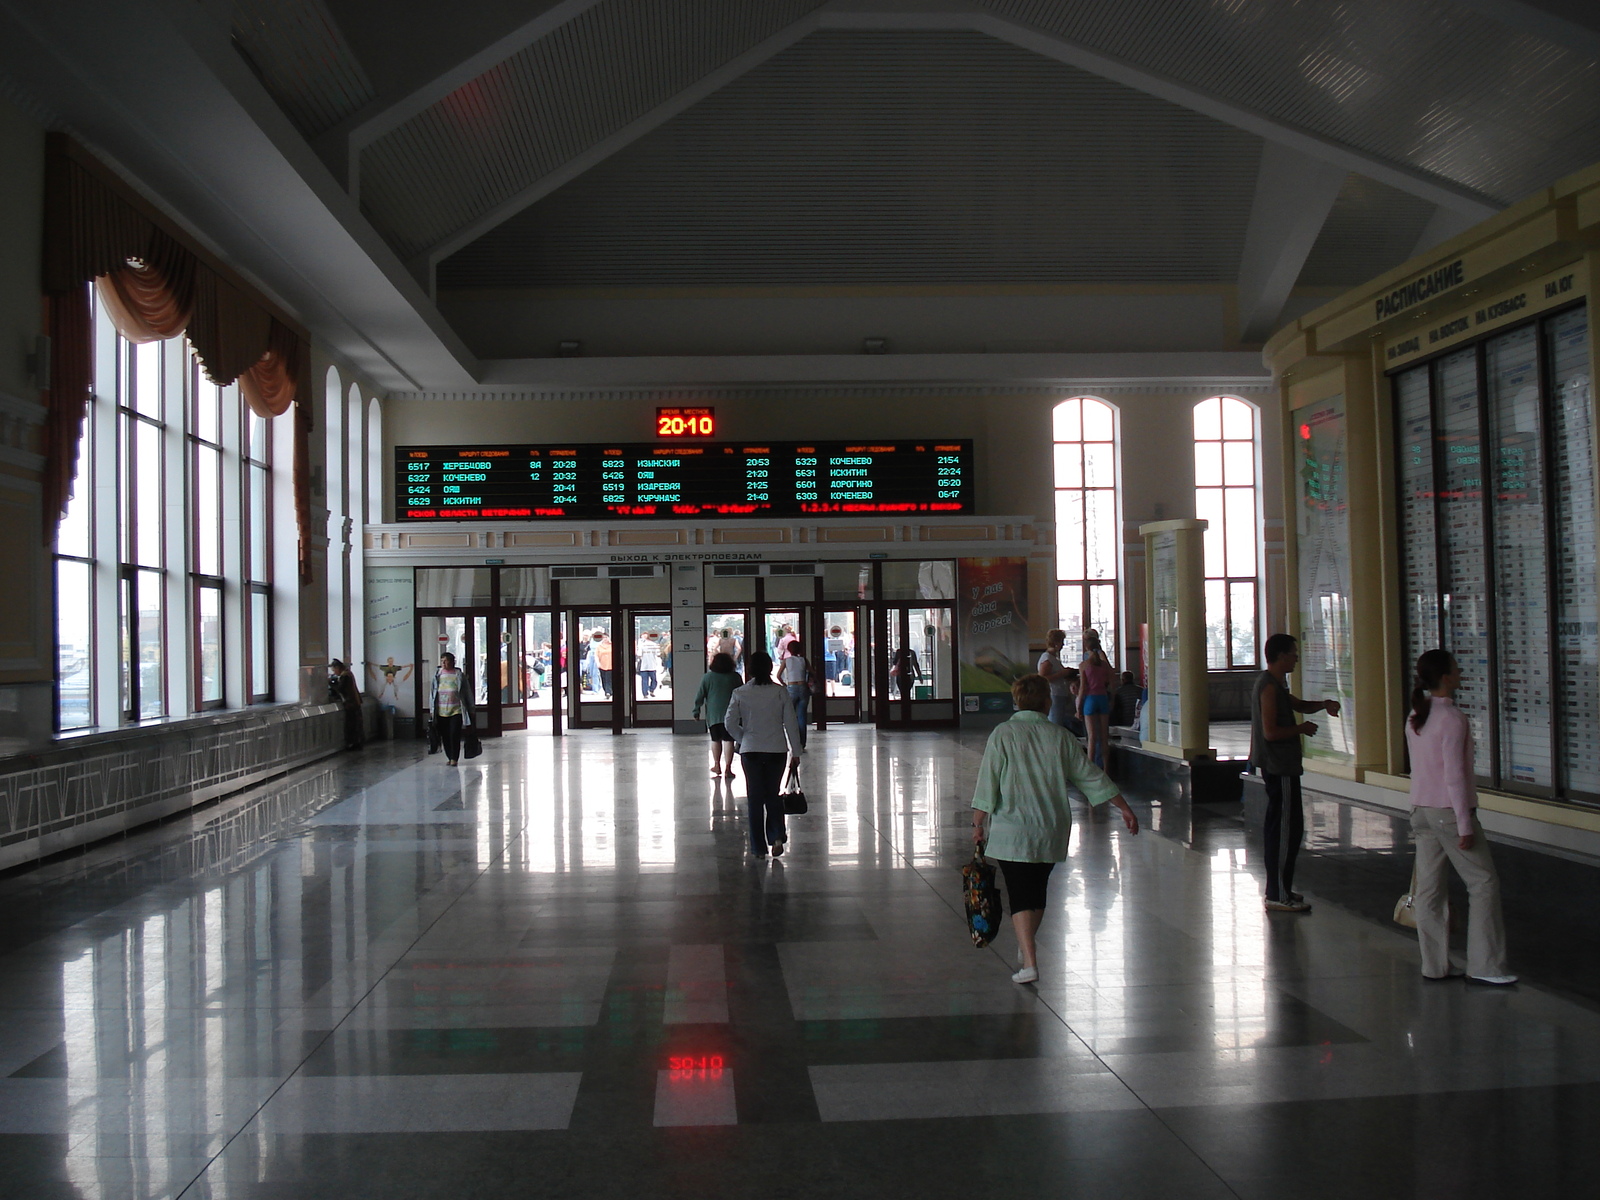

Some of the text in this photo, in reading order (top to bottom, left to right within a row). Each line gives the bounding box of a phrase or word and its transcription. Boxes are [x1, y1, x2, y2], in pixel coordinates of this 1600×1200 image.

[1376, 260, 1464, 320] РАСПИСАНИЕ
[1544, 274, 1573, 299] НА ЮГ
[1475, 293, 1526, 325] НА КУЗБАСС
[1440, 316, 1470, 340] ВОСТОК
[552, 460, 576, 468] 20:28
[602, 460, 624, 468] 6823
[746, 458, 770, 466] 20:53
[796, 458, 818, 466] 6329
[830, 456, 872, 464] КОЧЕНЕВО
[408, 462, 430, 470] 6517
[442, 462, 492, 470] ЖЕРЕБЦОВО
[530, 472, 540, 480] 12
[552, 472, 576, 480] 20:32
[602, 472, 624, 480] 6426
[638, 472, 654, 480] ОЯШ
[746, 470, 768, 478] 21:20
[796, 470, 816, 478] 6631
[830, 468, 868, 476] ИСКИТИМ
[938, 468, 960, 476] 22:24
[408, 474, 430, 482] 6327
[442, 474, 486, 482] КОЧЕНЕВО
[938, 478, 962, 486] 05:20
[554, 484, 576, 492] 20:41
[602, 484, 624, 492] 6519
[746, 482, 768, 490] 21:25
[796, 480, 816, 488] 6601
[830, 480, 872, 488] ДОРОГИНО
[408, 486, 430, 494] 6424
[442, 486, 460, 494] ОЯШ
[442, 496, 482, 504] ИСКИТИМ
[554, 496, 576, 504] 20:44
[602, 494, 624, 502] 6825
[746, 492, 768, 500] 21:40
[796, 492, 818, 500] 6303
[830, 492, 872, 500] КОЧЕНЕВО
[408, 498, 430, 506] 6629
[972, 581, 1004, 600] У нас
[972, 600, 997, 617] одна
[972, 611, 1013, 635] дорога!
